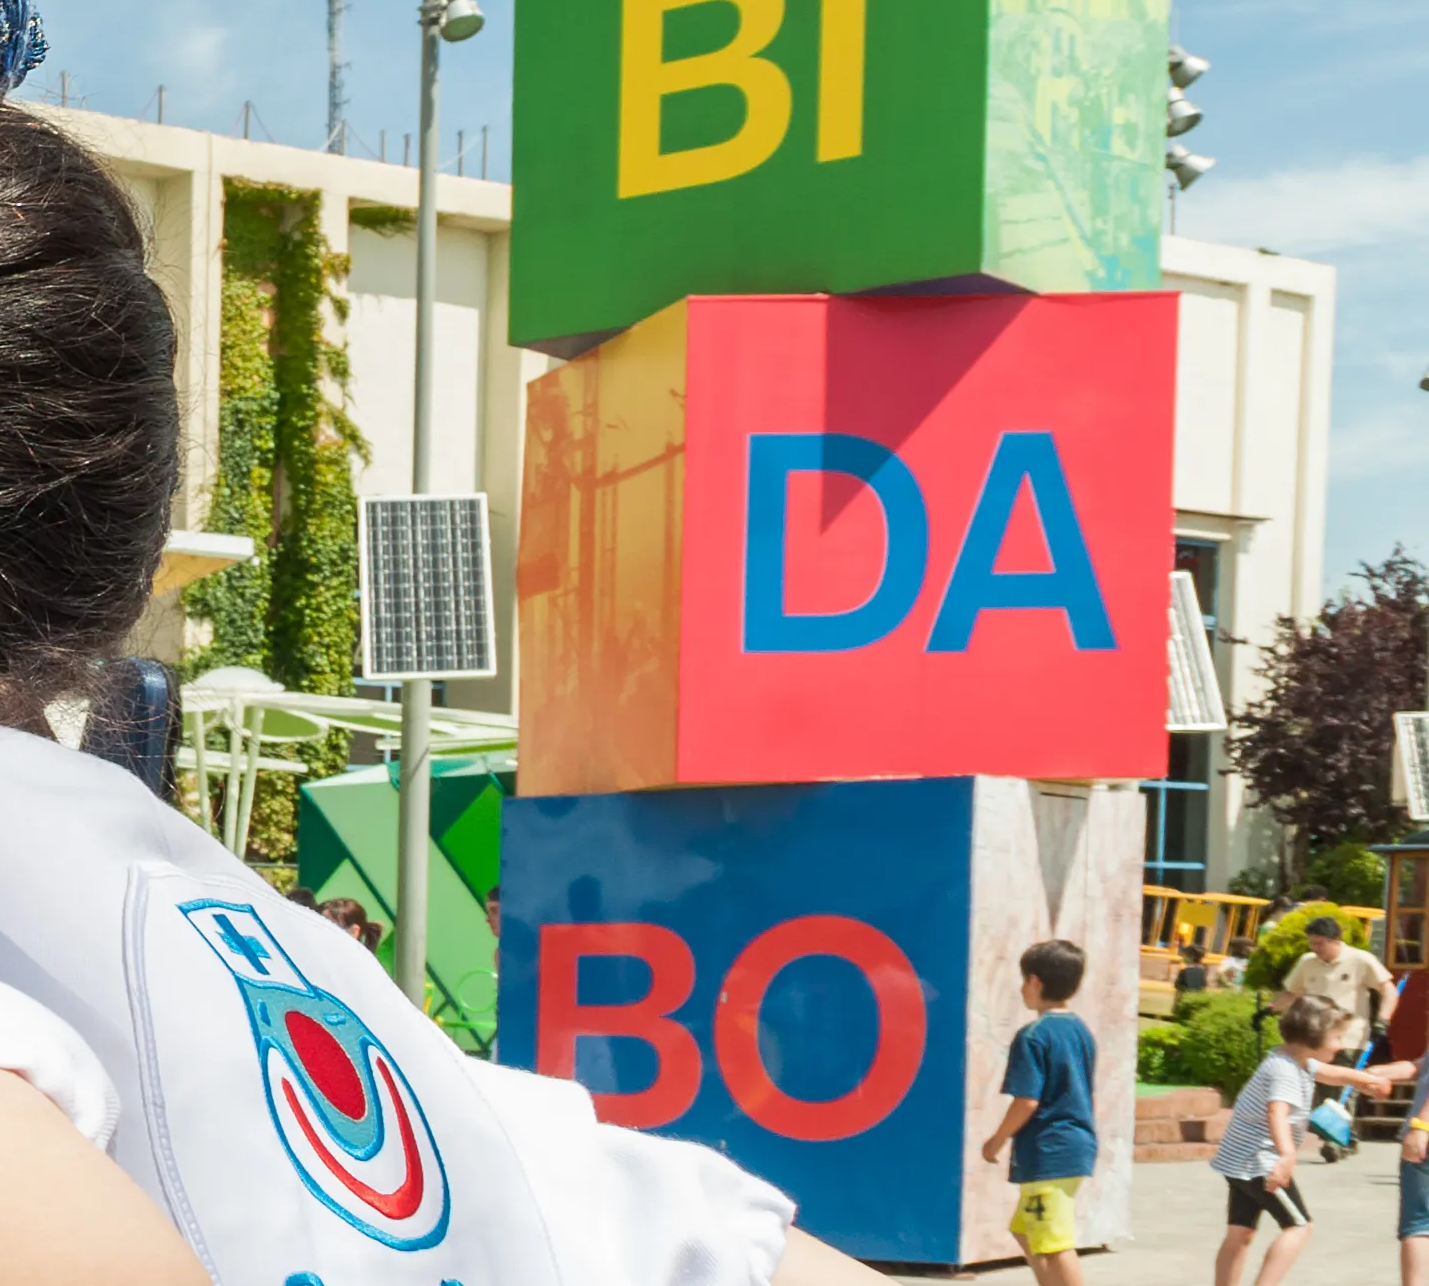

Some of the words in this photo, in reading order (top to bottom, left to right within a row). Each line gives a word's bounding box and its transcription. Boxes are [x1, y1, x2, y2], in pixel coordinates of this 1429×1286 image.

[741, 430, 1119, 653] DA
[536, 913, 927, 1141] BO
[1025, 1194, 1045, 1221] 4
